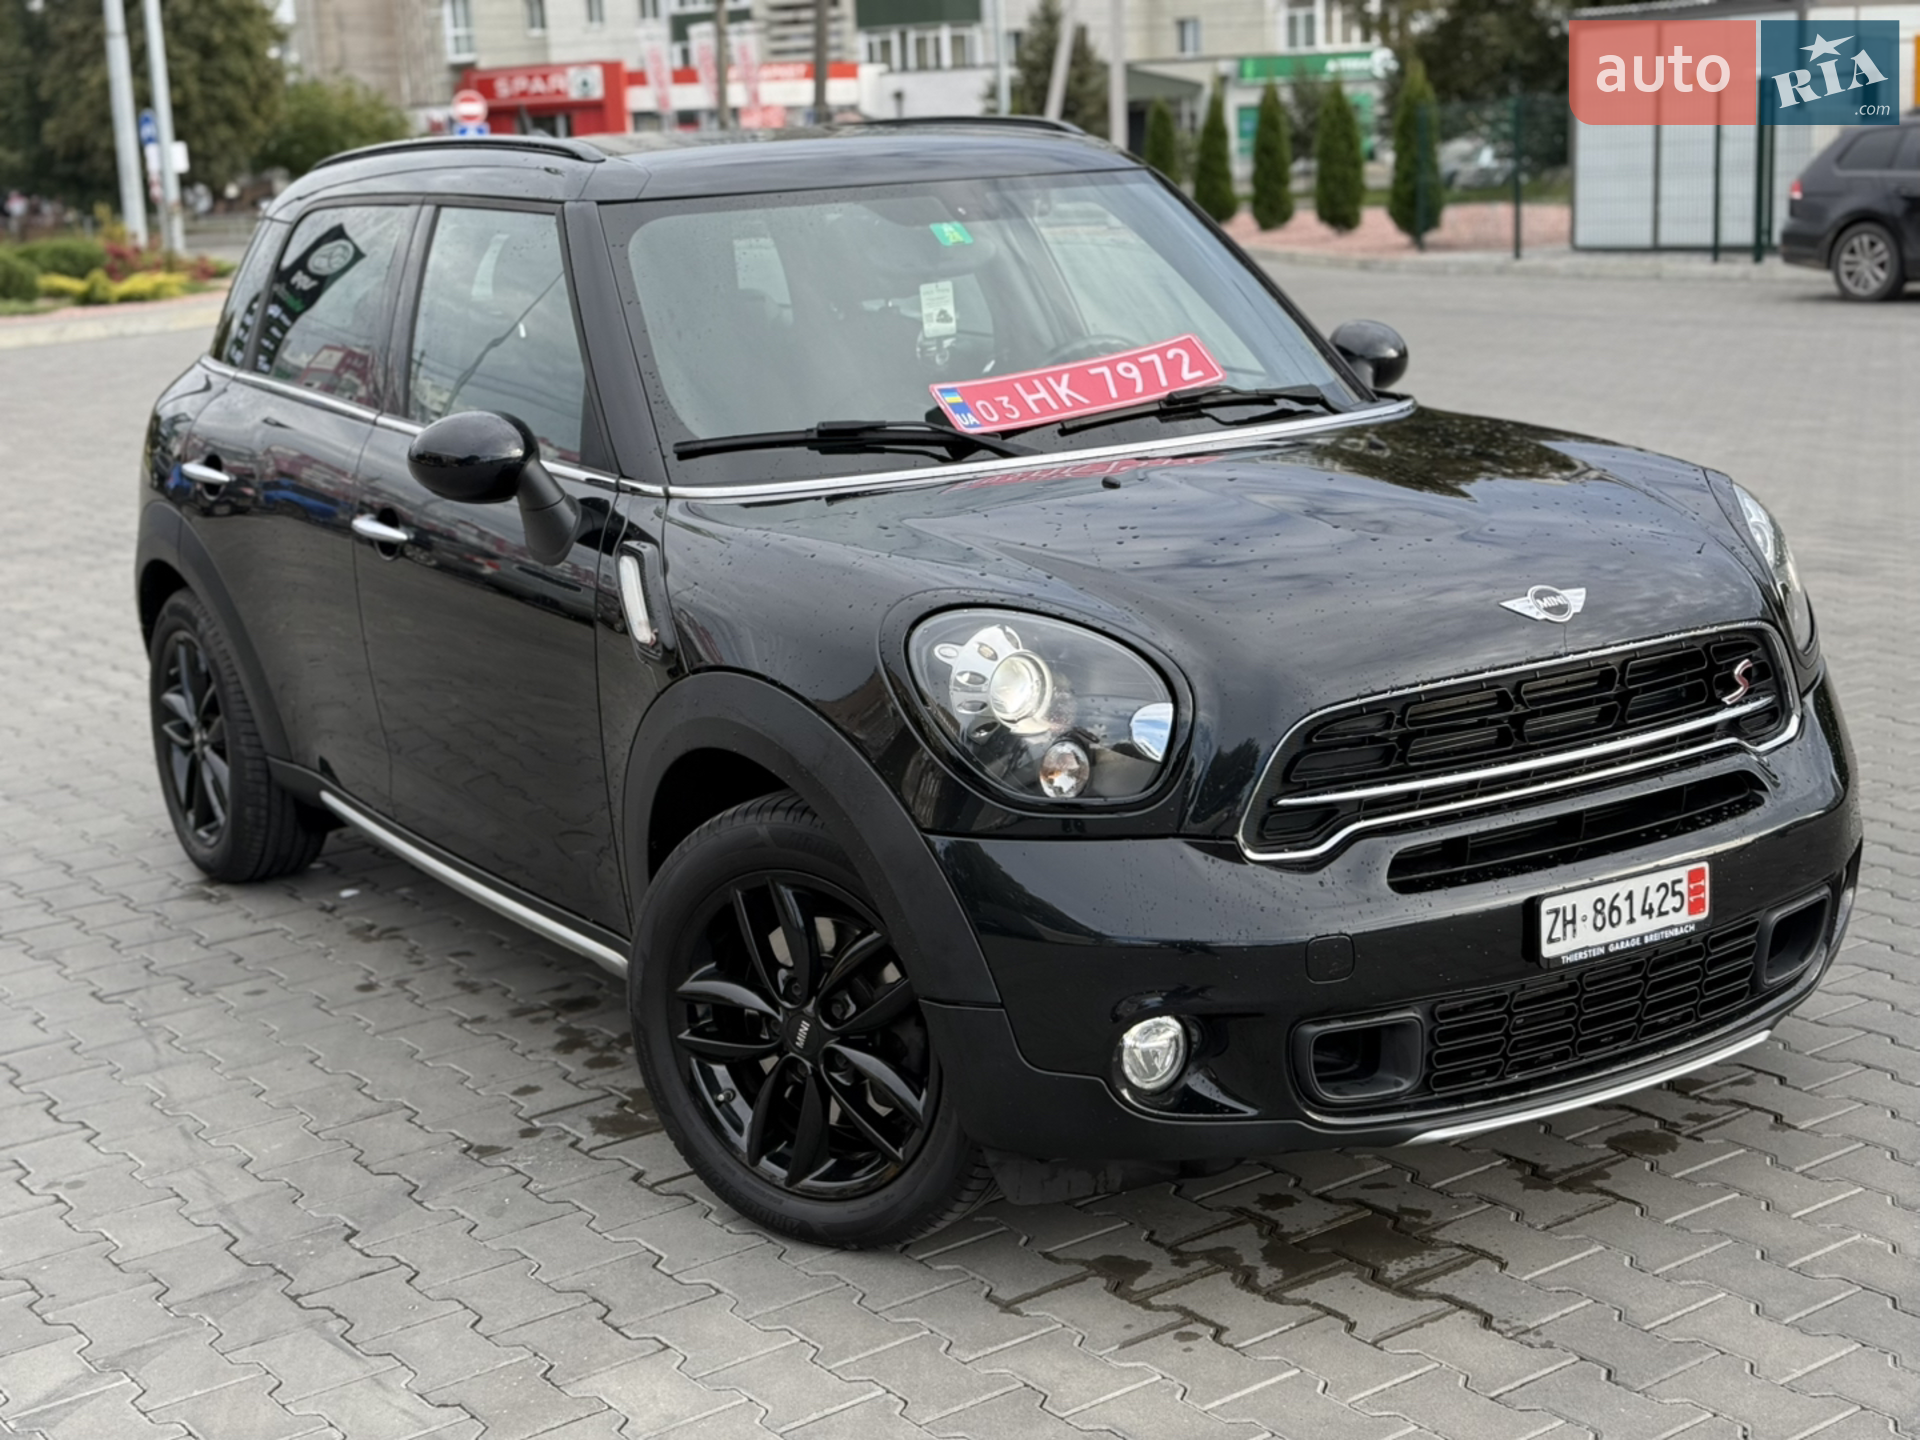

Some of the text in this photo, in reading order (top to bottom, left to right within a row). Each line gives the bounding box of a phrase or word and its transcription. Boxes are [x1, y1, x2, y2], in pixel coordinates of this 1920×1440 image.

[494, 73, 567, 98] SPAR
[975, 395, 1021, 423] 03
[1087, 348, 1205, 399] 7972
[956, 412, 980, 427] UA
[1536, 594, 1567, 609] MINI
[1721, 658, 1752, 705] S
[1592, 878, 1685, 932] 861425
[1561, 923, 1696, 965] THIERSTEIN GARAGE BREITENBACH
[795, 1020, 811, 1049] MINI
